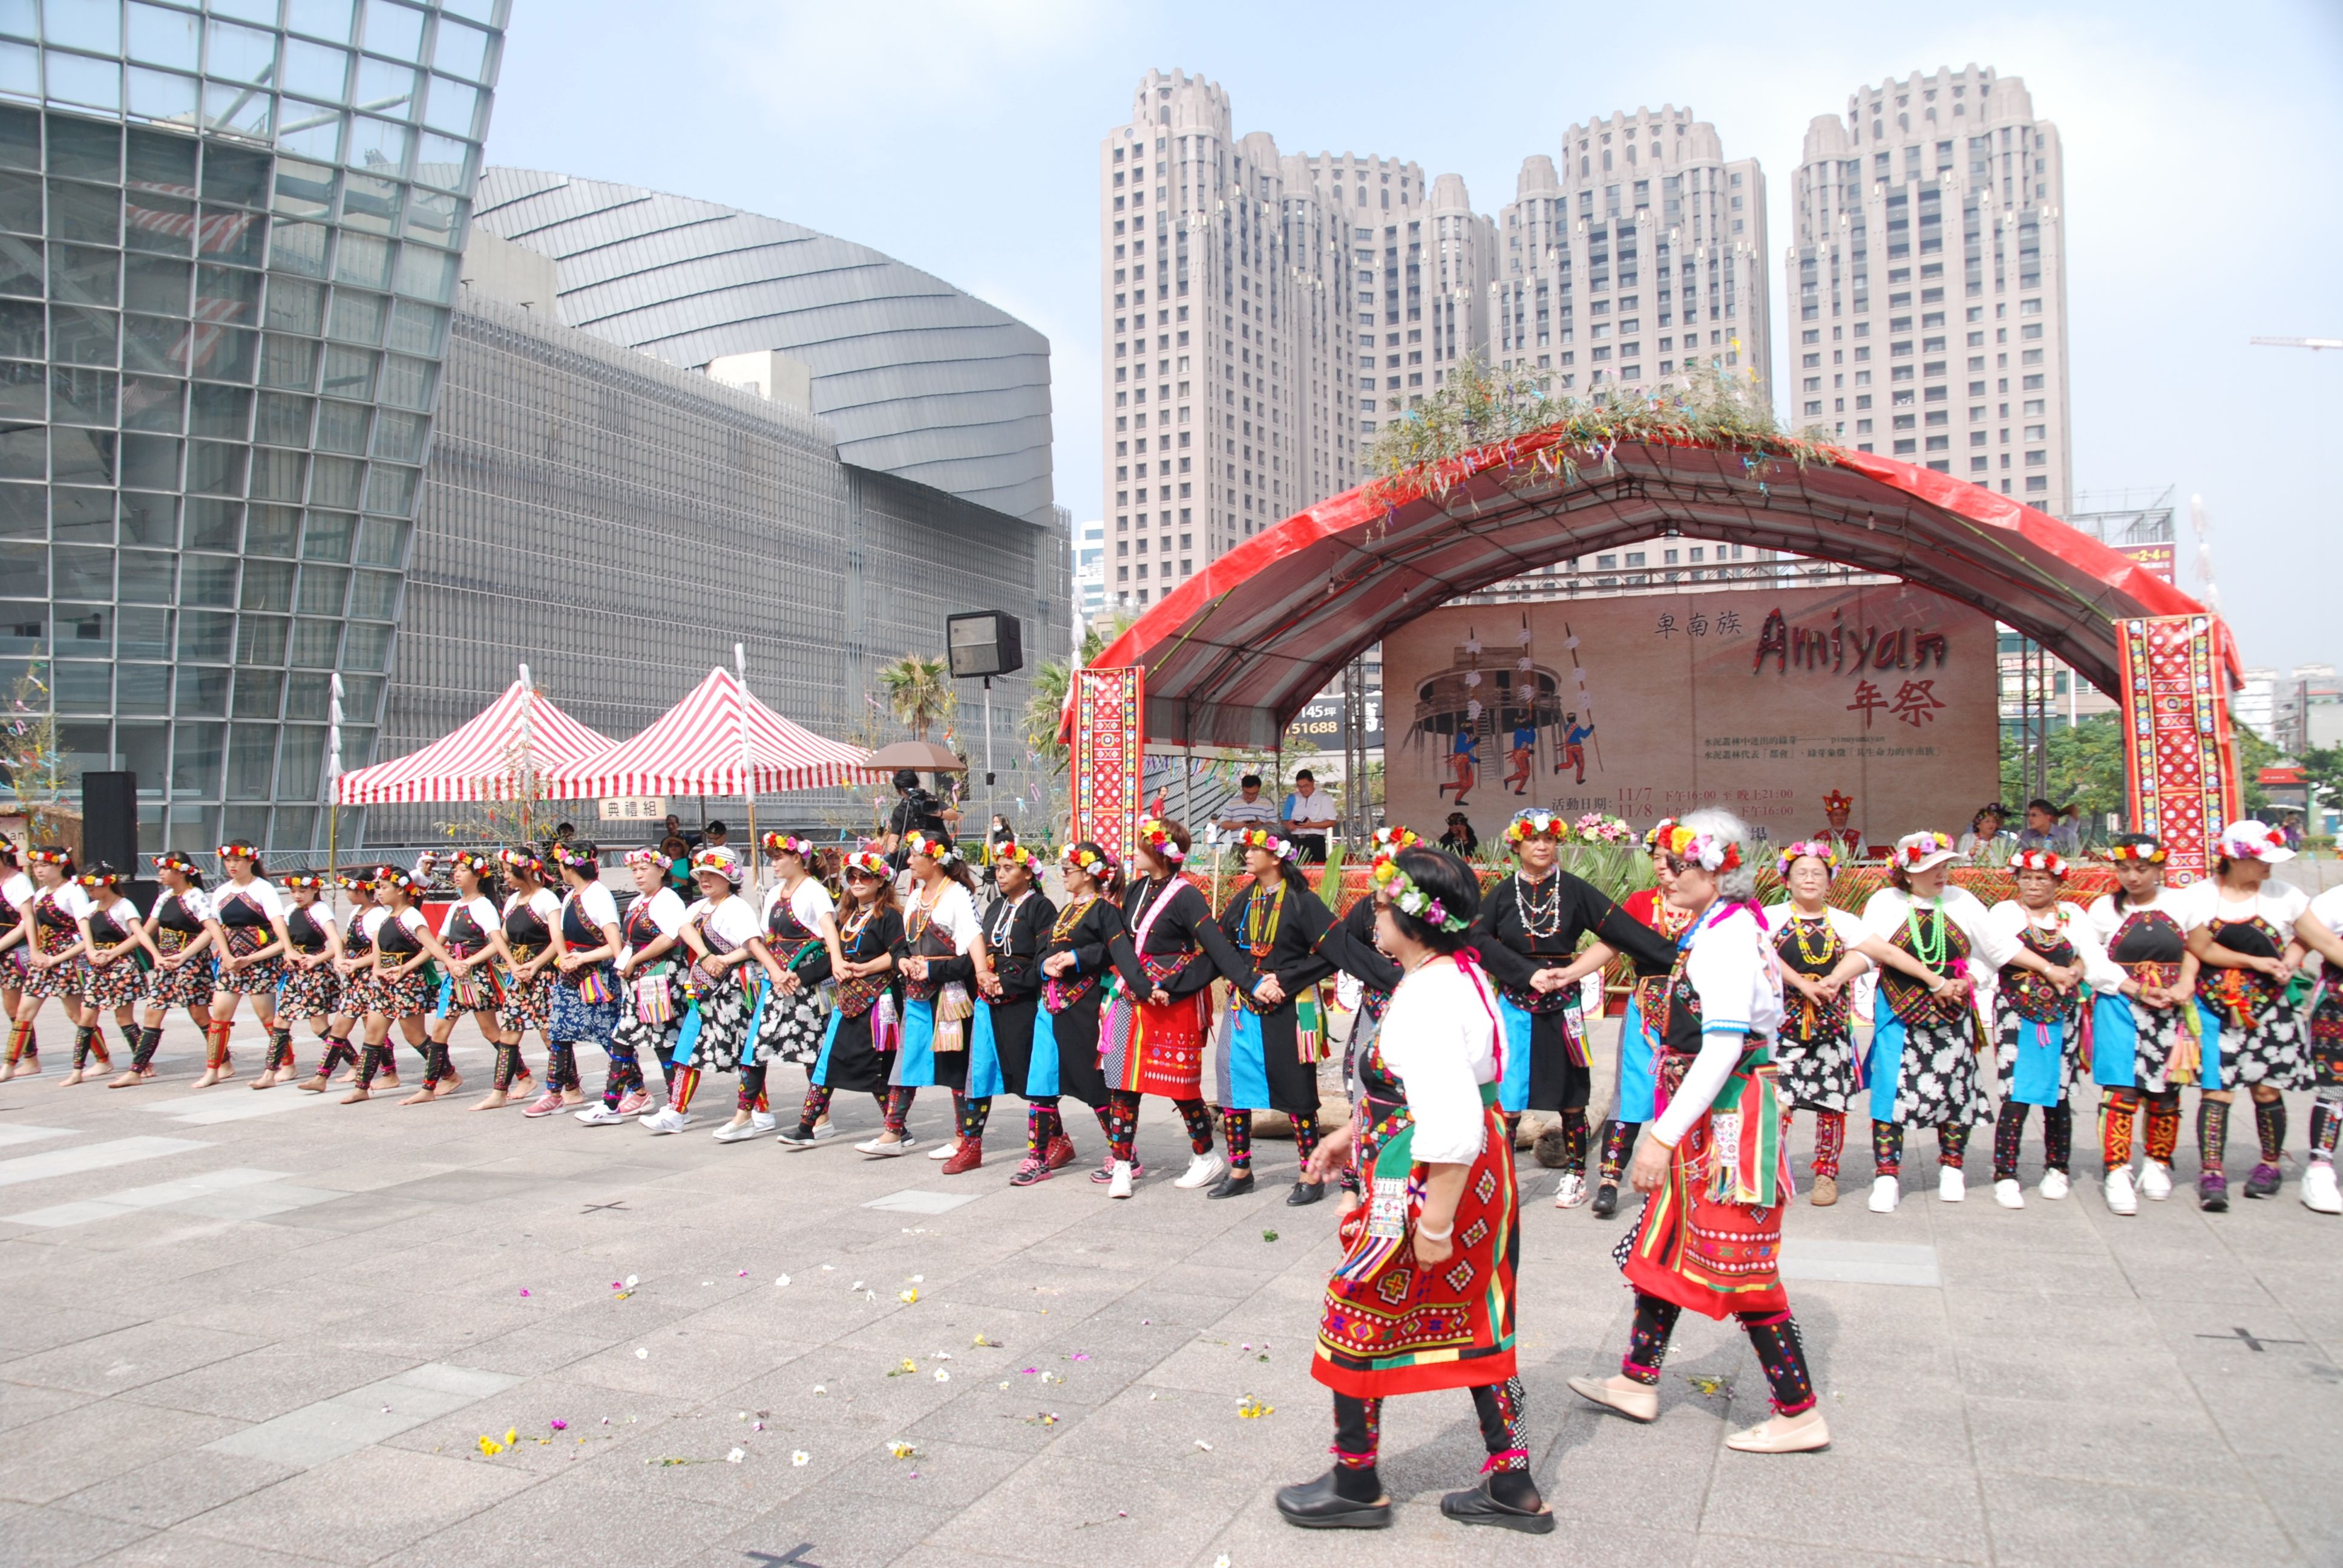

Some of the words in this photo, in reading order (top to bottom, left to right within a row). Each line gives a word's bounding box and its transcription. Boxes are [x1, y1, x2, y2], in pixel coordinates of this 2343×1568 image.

[1654, 610, 1743, 639] 卑南族
[1753, 607, 1947, 676] Amiyan
[1846, 679, 1947, 730] 年祭
[1618, 788, 1653, 802] 11/7
[608, 801, 657, 817] 典禮組
[1618, 803, 1653, 817] 11/8
[1742, 806, 1794, 817] 下午16:00
